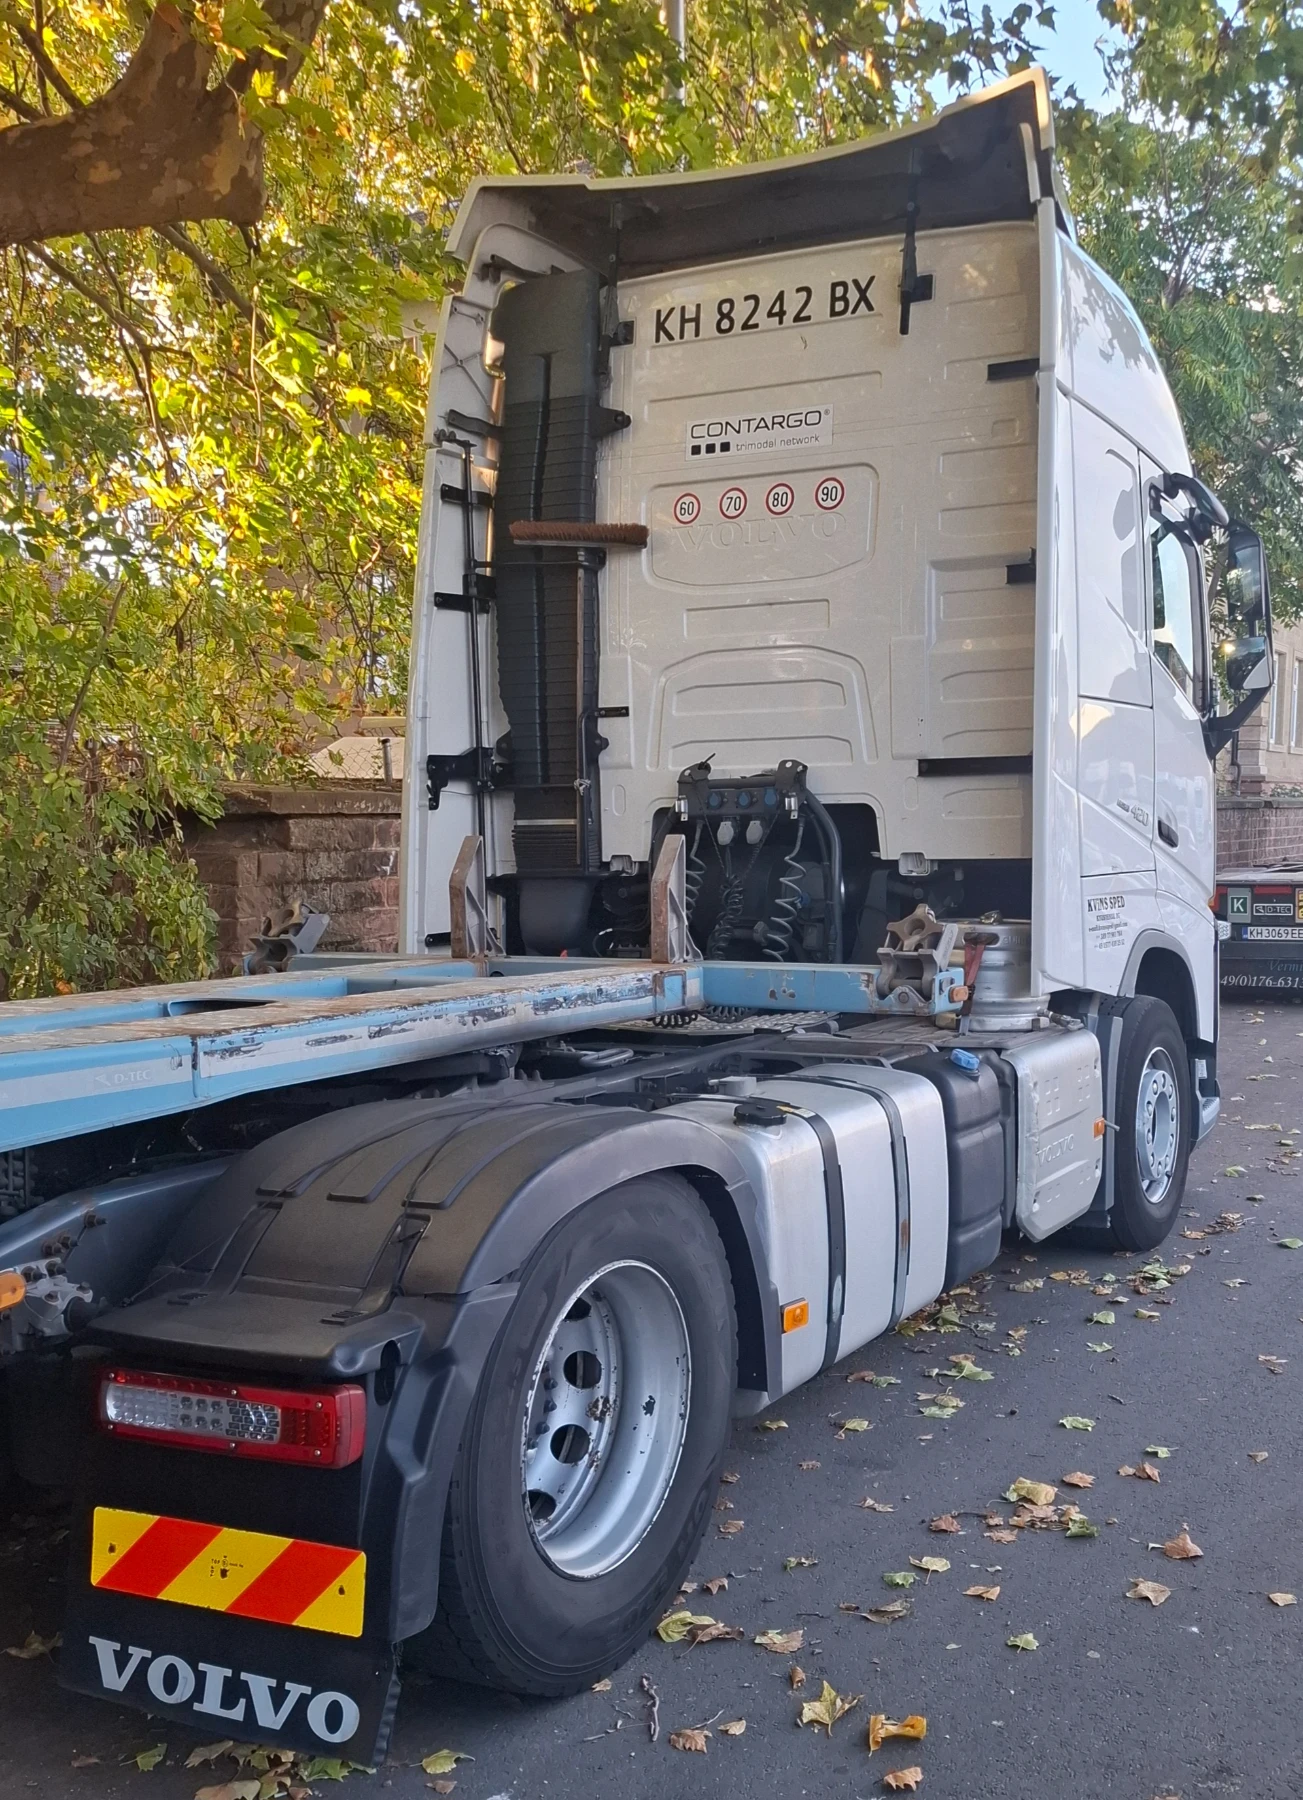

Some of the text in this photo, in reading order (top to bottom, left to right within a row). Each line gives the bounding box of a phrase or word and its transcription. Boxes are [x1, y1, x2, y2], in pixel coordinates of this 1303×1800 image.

[654, 275, 876, 343] KH 8242 BX
[735, 434, 820, 452] trimodal network
[772, 491, 789, 508] 80
[821, 485, 838, 503] 90
[679, 500, 695, 517] 60
[725, 495, 742, 513] 70
[672, 511, 847, 553] VOLVO
[1109, 895, 1126, 909] SPED
[1233, 898, 1244, 912] K
[1249, 928, 1263, 938] KH
[1264, 928, 1289, 939] 3069
[114, 1070, 151, 1084] D-TEC
[88, 1635, 360, 1743] VOLVO
